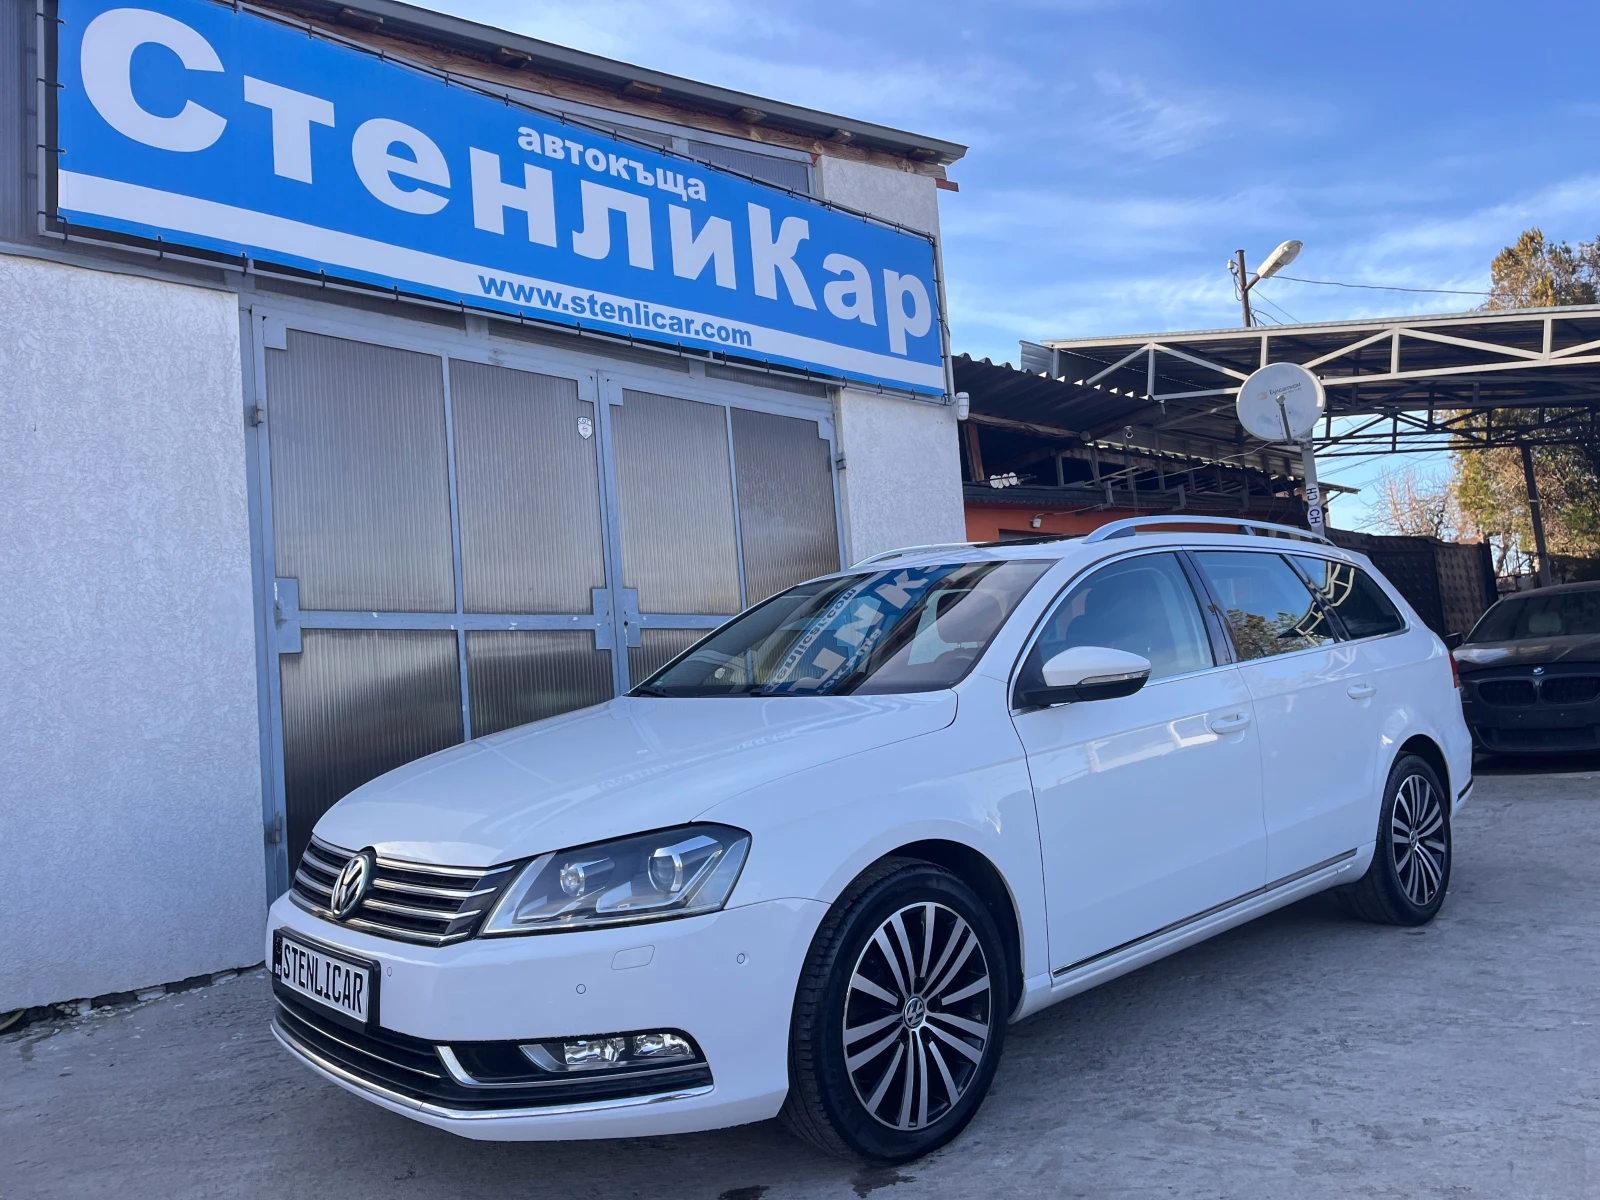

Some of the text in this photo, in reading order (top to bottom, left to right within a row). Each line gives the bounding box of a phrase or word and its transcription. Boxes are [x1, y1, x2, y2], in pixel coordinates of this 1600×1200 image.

[80, 7, 932, 356] СтенлиКар
[517, 126, 707, 202] автокъща
[478, 274, 752, 347] www.stenlicar.com
[283, 943, 363, 1014] STENLICAR
